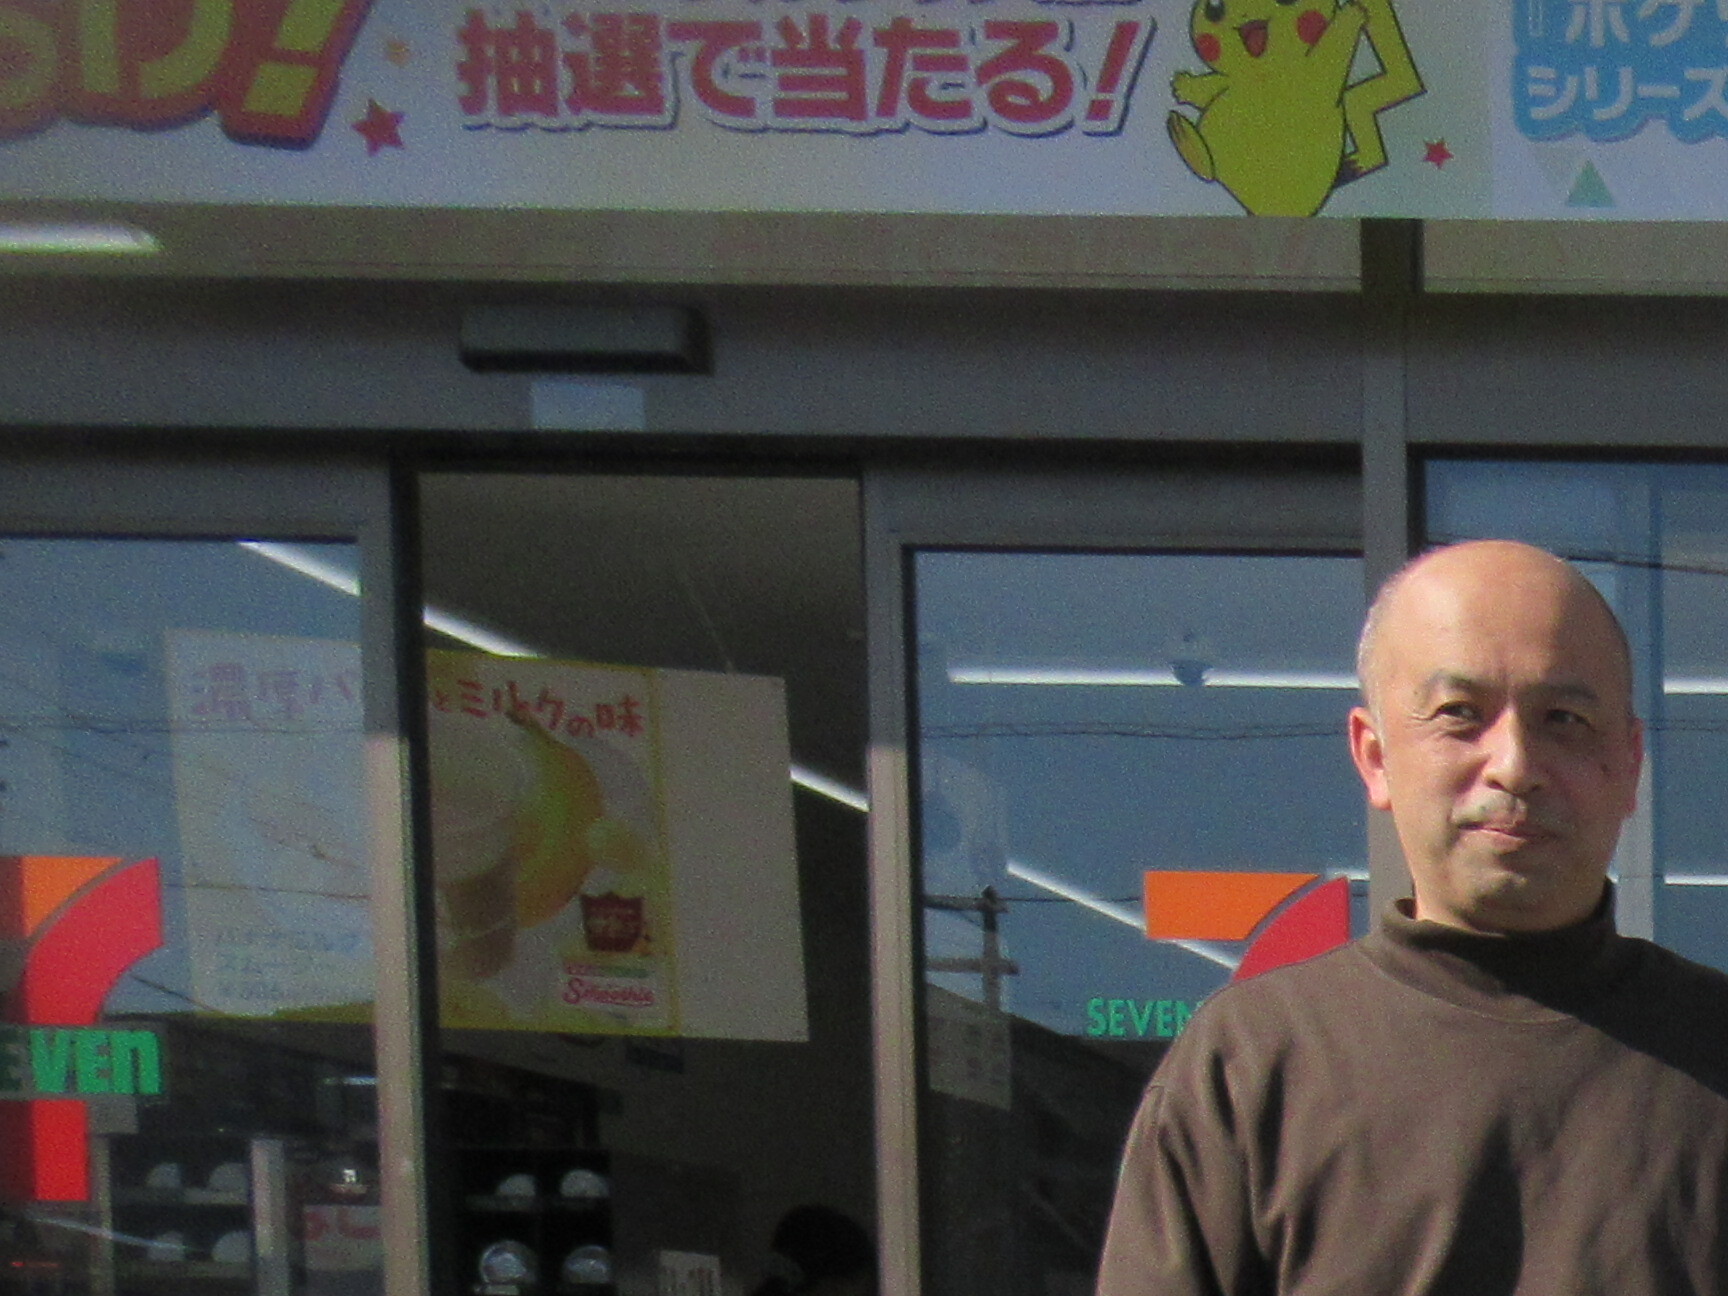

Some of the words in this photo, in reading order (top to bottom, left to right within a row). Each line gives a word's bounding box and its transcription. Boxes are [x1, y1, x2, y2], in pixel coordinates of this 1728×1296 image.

[456, 12, 1142, 122] 抽選で当たる!
